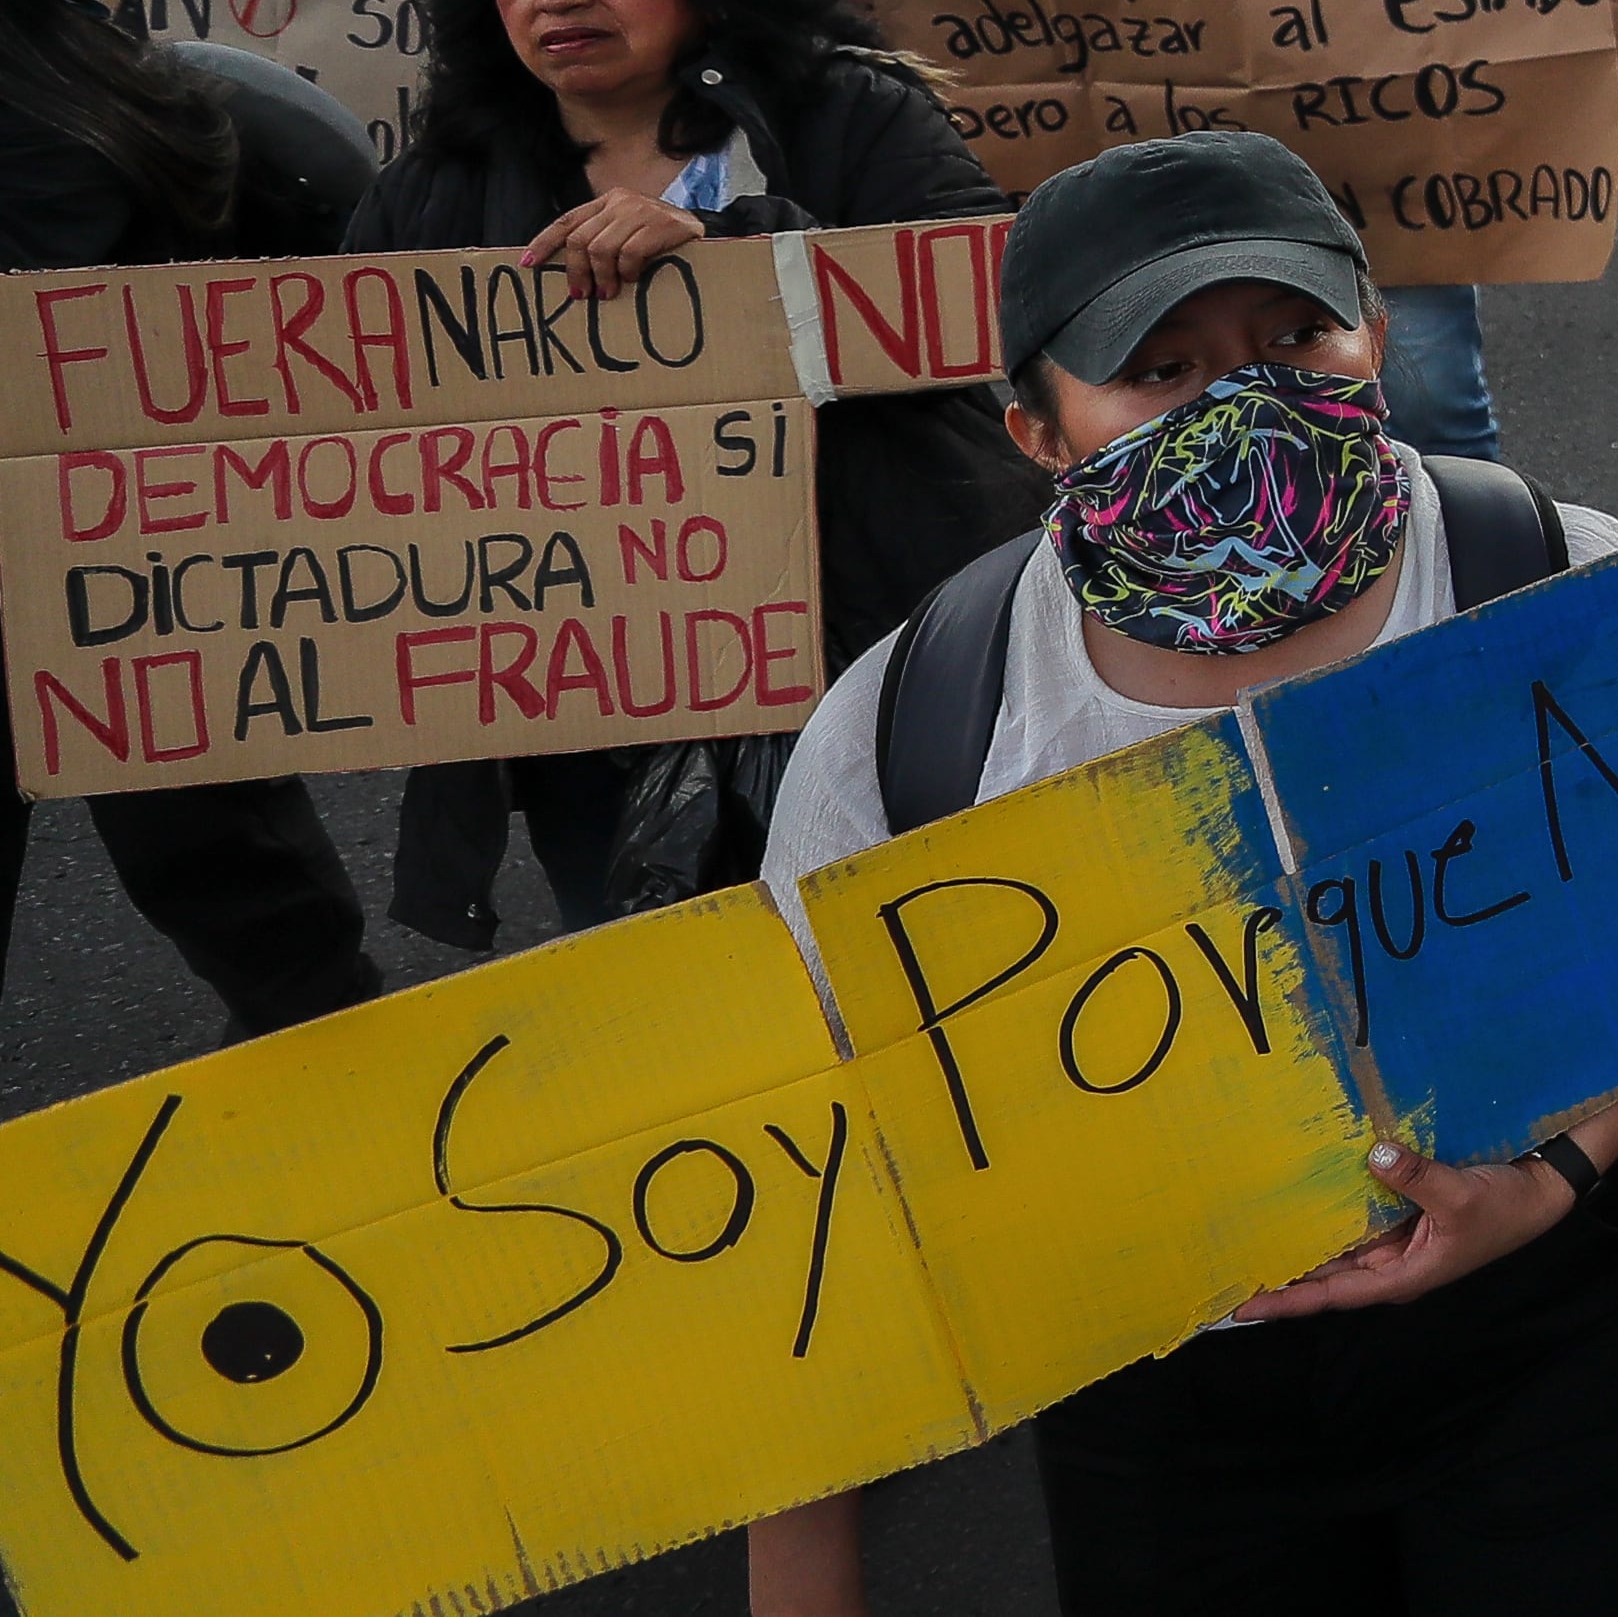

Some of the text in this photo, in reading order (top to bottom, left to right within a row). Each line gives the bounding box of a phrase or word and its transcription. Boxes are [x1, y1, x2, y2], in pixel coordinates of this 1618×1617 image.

[1106, 93, 1138, 135] a
[1292, 58, 1507, 132] RICOS
[1393, 164, 1615, 231] COBRADO
[35, 265, 412, 433] FUERA
[617, 513, 729, 585] NO
[34, 600, 814, 776] NO AL FRAUDE
[0, 1093, 384, 1561] Yo
[432, 1033, 849, 1359] Soy
